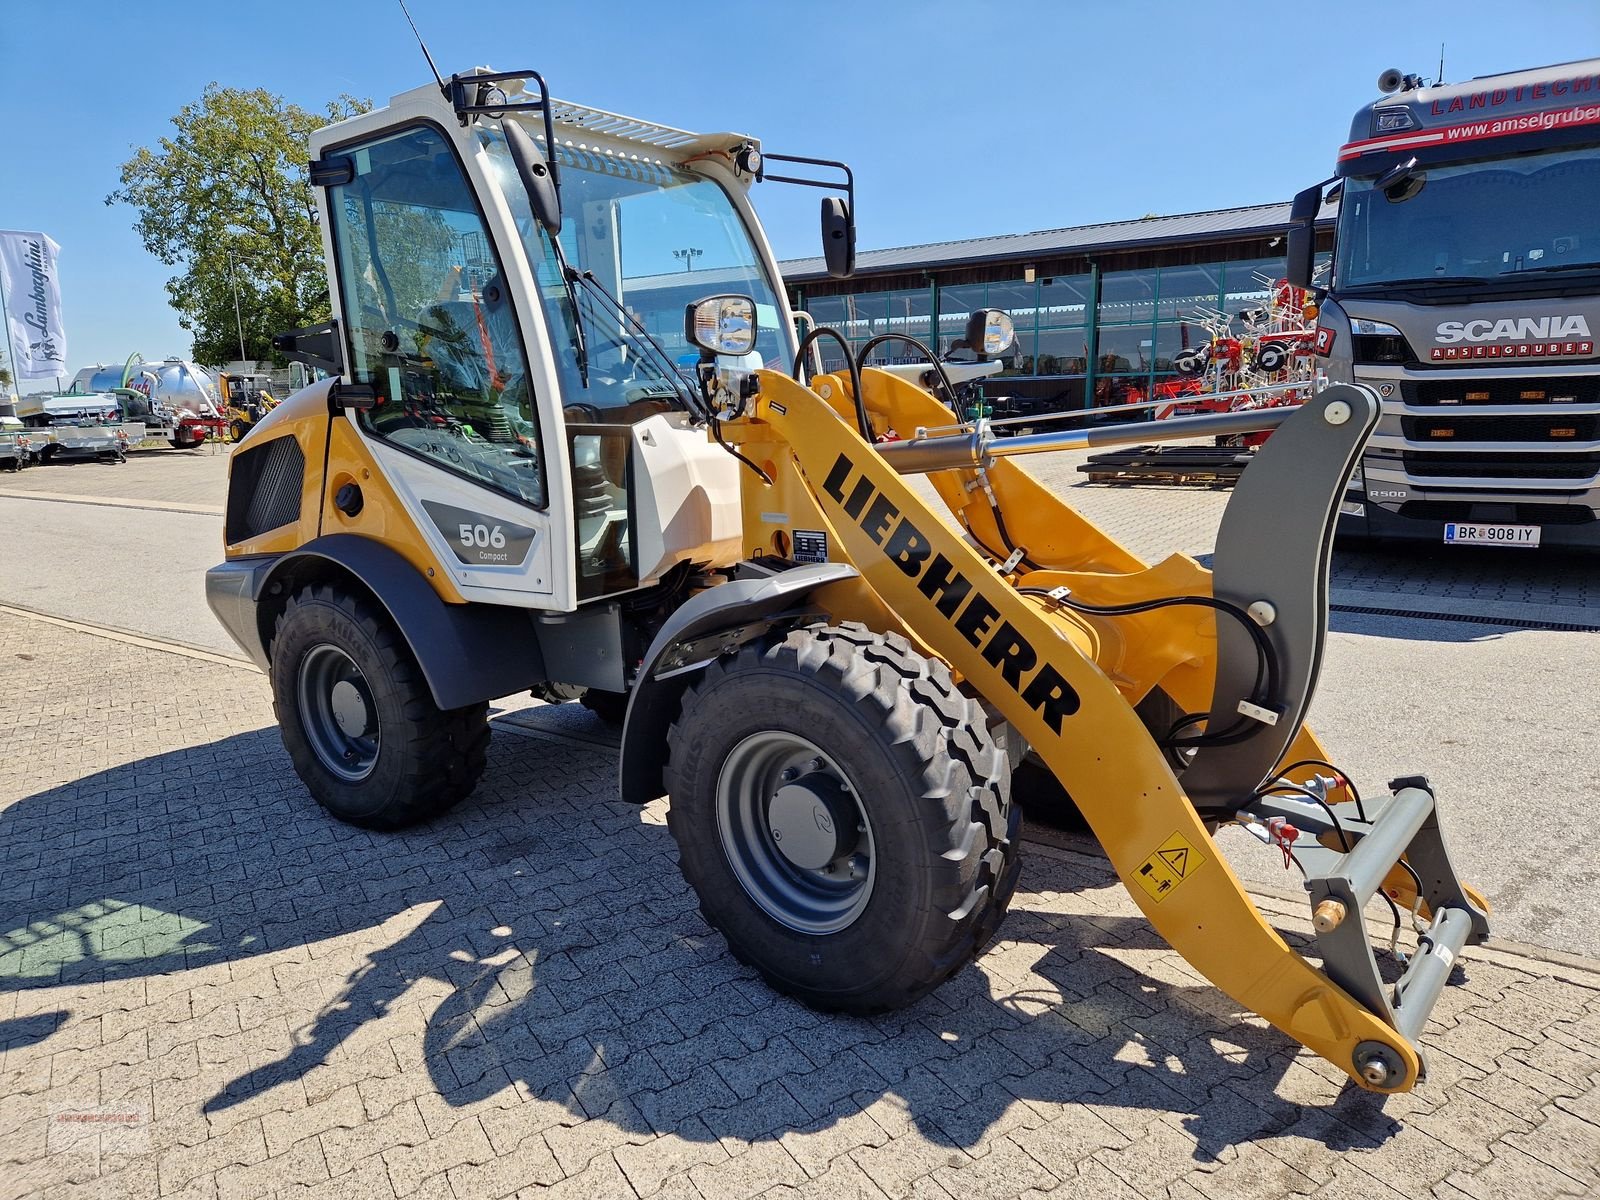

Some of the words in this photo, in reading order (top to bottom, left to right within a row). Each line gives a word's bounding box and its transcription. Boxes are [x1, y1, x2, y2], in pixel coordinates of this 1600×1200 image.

[23, 239, 50, 338] Lamborghini
[1435, 315, 1591, 344] SCANIA
[1432, 343, 1590, 357] AMSELGRUBER
[459, 524, 506, 549] 506
[480, 551, 508, 563] Compact
[823, 452, 1081, 738] LIEBHERR
